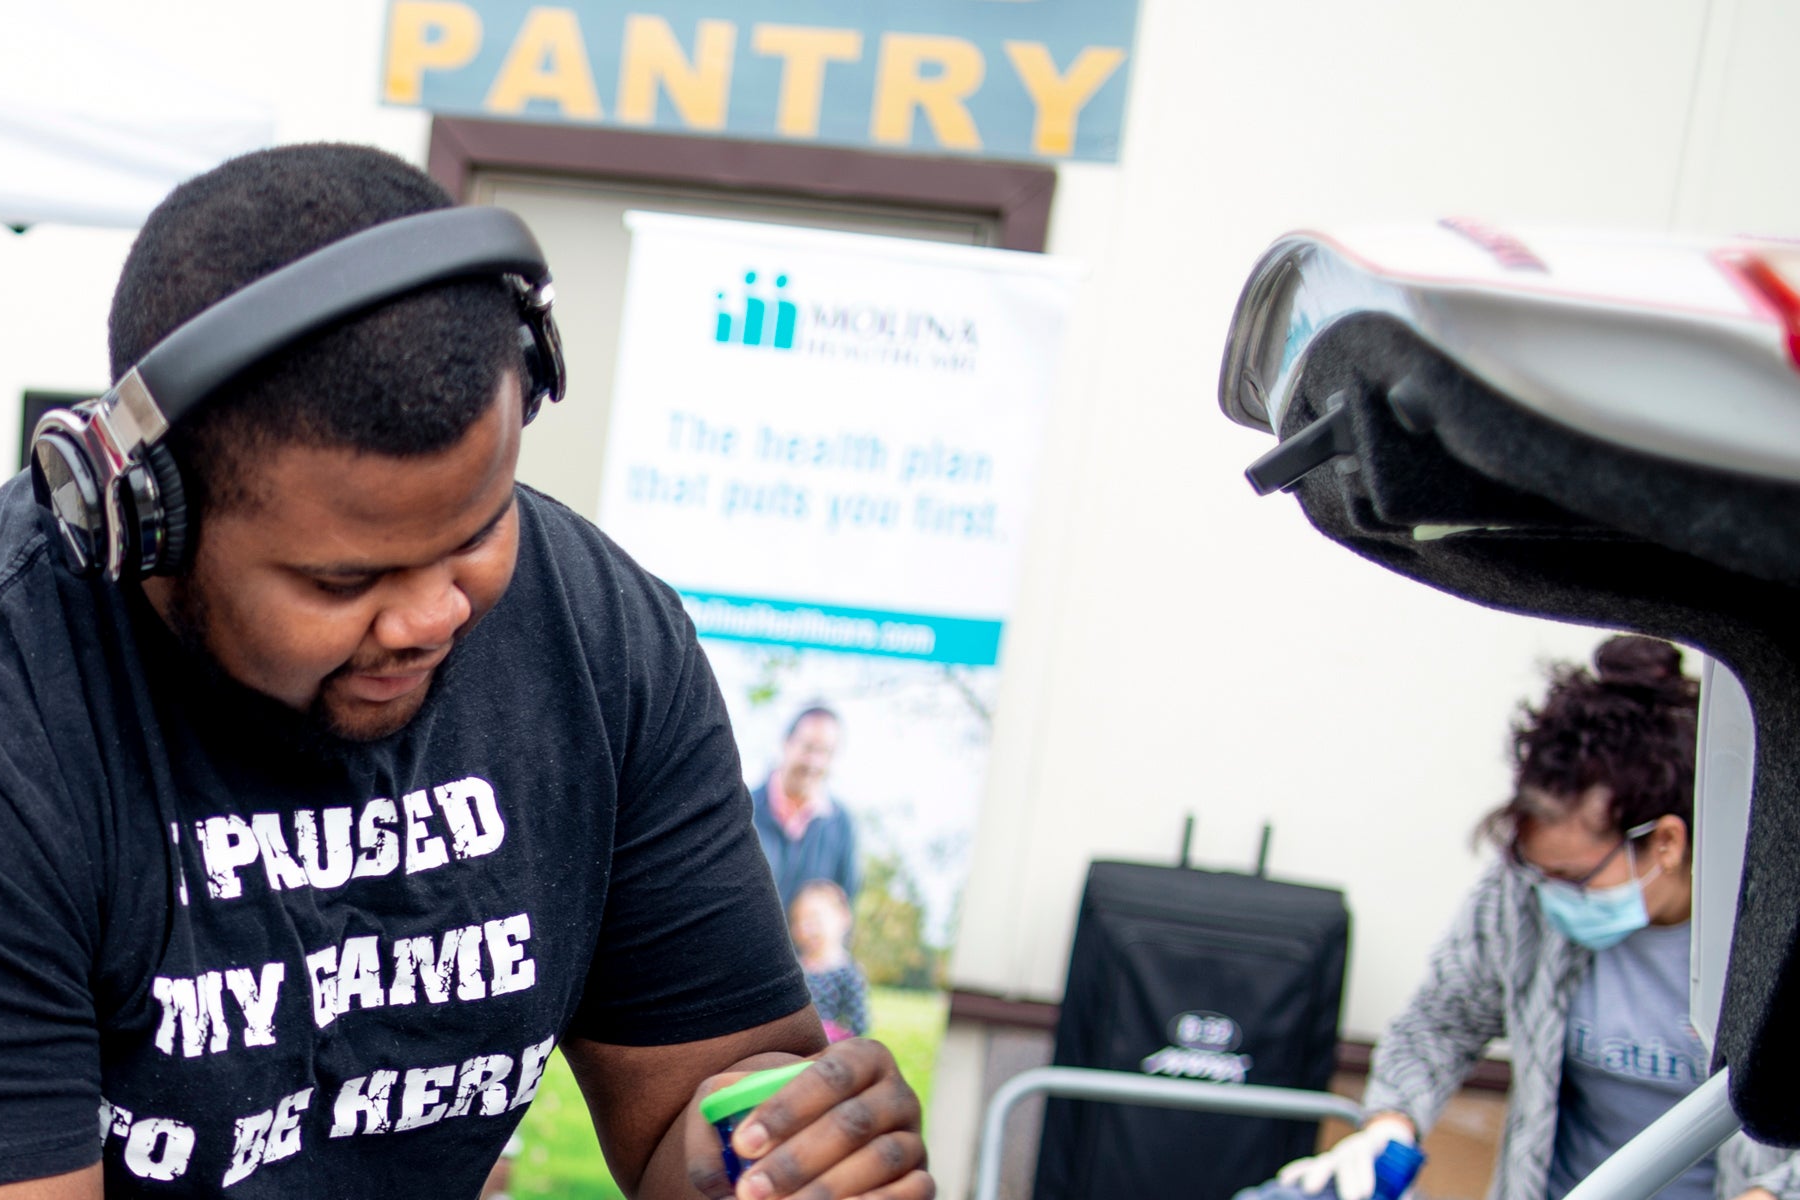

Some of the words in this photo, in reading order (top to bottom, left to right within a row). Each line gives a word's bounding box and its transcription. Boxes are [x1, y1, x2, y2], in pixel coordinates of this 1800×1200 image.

[385, 0, 1126, 158] PANTRY
[628, 464, 708, 505] that
[724, 479, 809, 519] puts
[827, 493, 899, 535] you
[667, 409, 737, 455] The
[758, 423, 886, 470] health
[902, 439, 993, 483] plan
[195, 776, 506, 900] PAUSED
[153, 963, 284, 1058] MY
[305, 913, 536, 1029] GAME
[221, 1087, 316, 1189] BE
[328, 1033, 556, 1139] HERE
